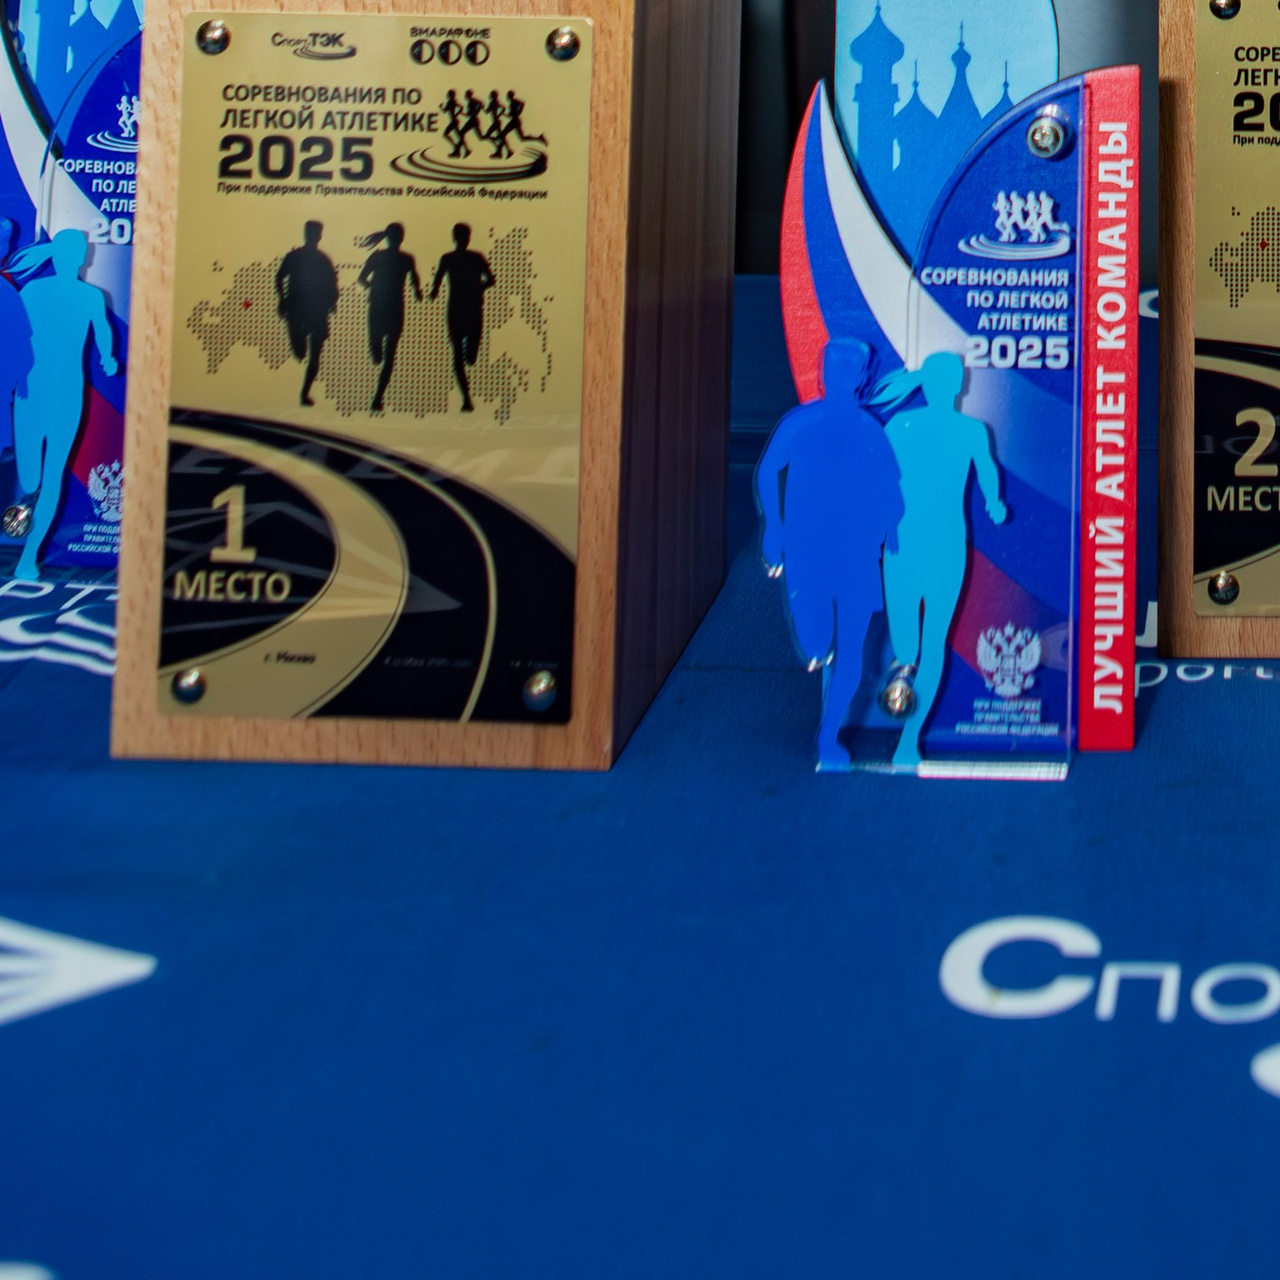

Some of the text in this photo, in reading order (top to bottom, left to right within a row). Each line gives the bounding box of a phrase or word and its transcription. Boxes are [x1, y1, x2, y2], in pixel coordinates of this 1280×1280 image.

[222, 83, 423, 106] СОРЕВНОВАНИЯ ПО
[220, 104, 440, 132] ЛЕГКОЙ АТЛЕТИКЕ
[1233, 135, 1255, 146] При
[55, 158, 138, 175] СОРЕВНОВ
[217, 134, 375, 181] 2025
[92, 179, 114, 193] ПО
[217, 181, 548, 201] При поддержке Правительства Российской Федерации
[100, 198, 138, 213] АТЛЕ
[88, 217, 133, 245] 20
[920, 266, 1069, 287] СОРЕВНОВАНИЯ
[966, 287, 1069, 310] ПО ЛЕГКОЙ
[977, 311, 1068, 333] АТЛЕТИКЕ
[965, 336, 1070, 370] 2025
[1089, 121, 1134, 715] ЛУЧШИЙ АТЛЕТ КОМАНДЫ
[1234, 407, 1278, 477] 2
[209, 484, 257, 564] 1
[173, 569, 293, 602] МЕСТО
